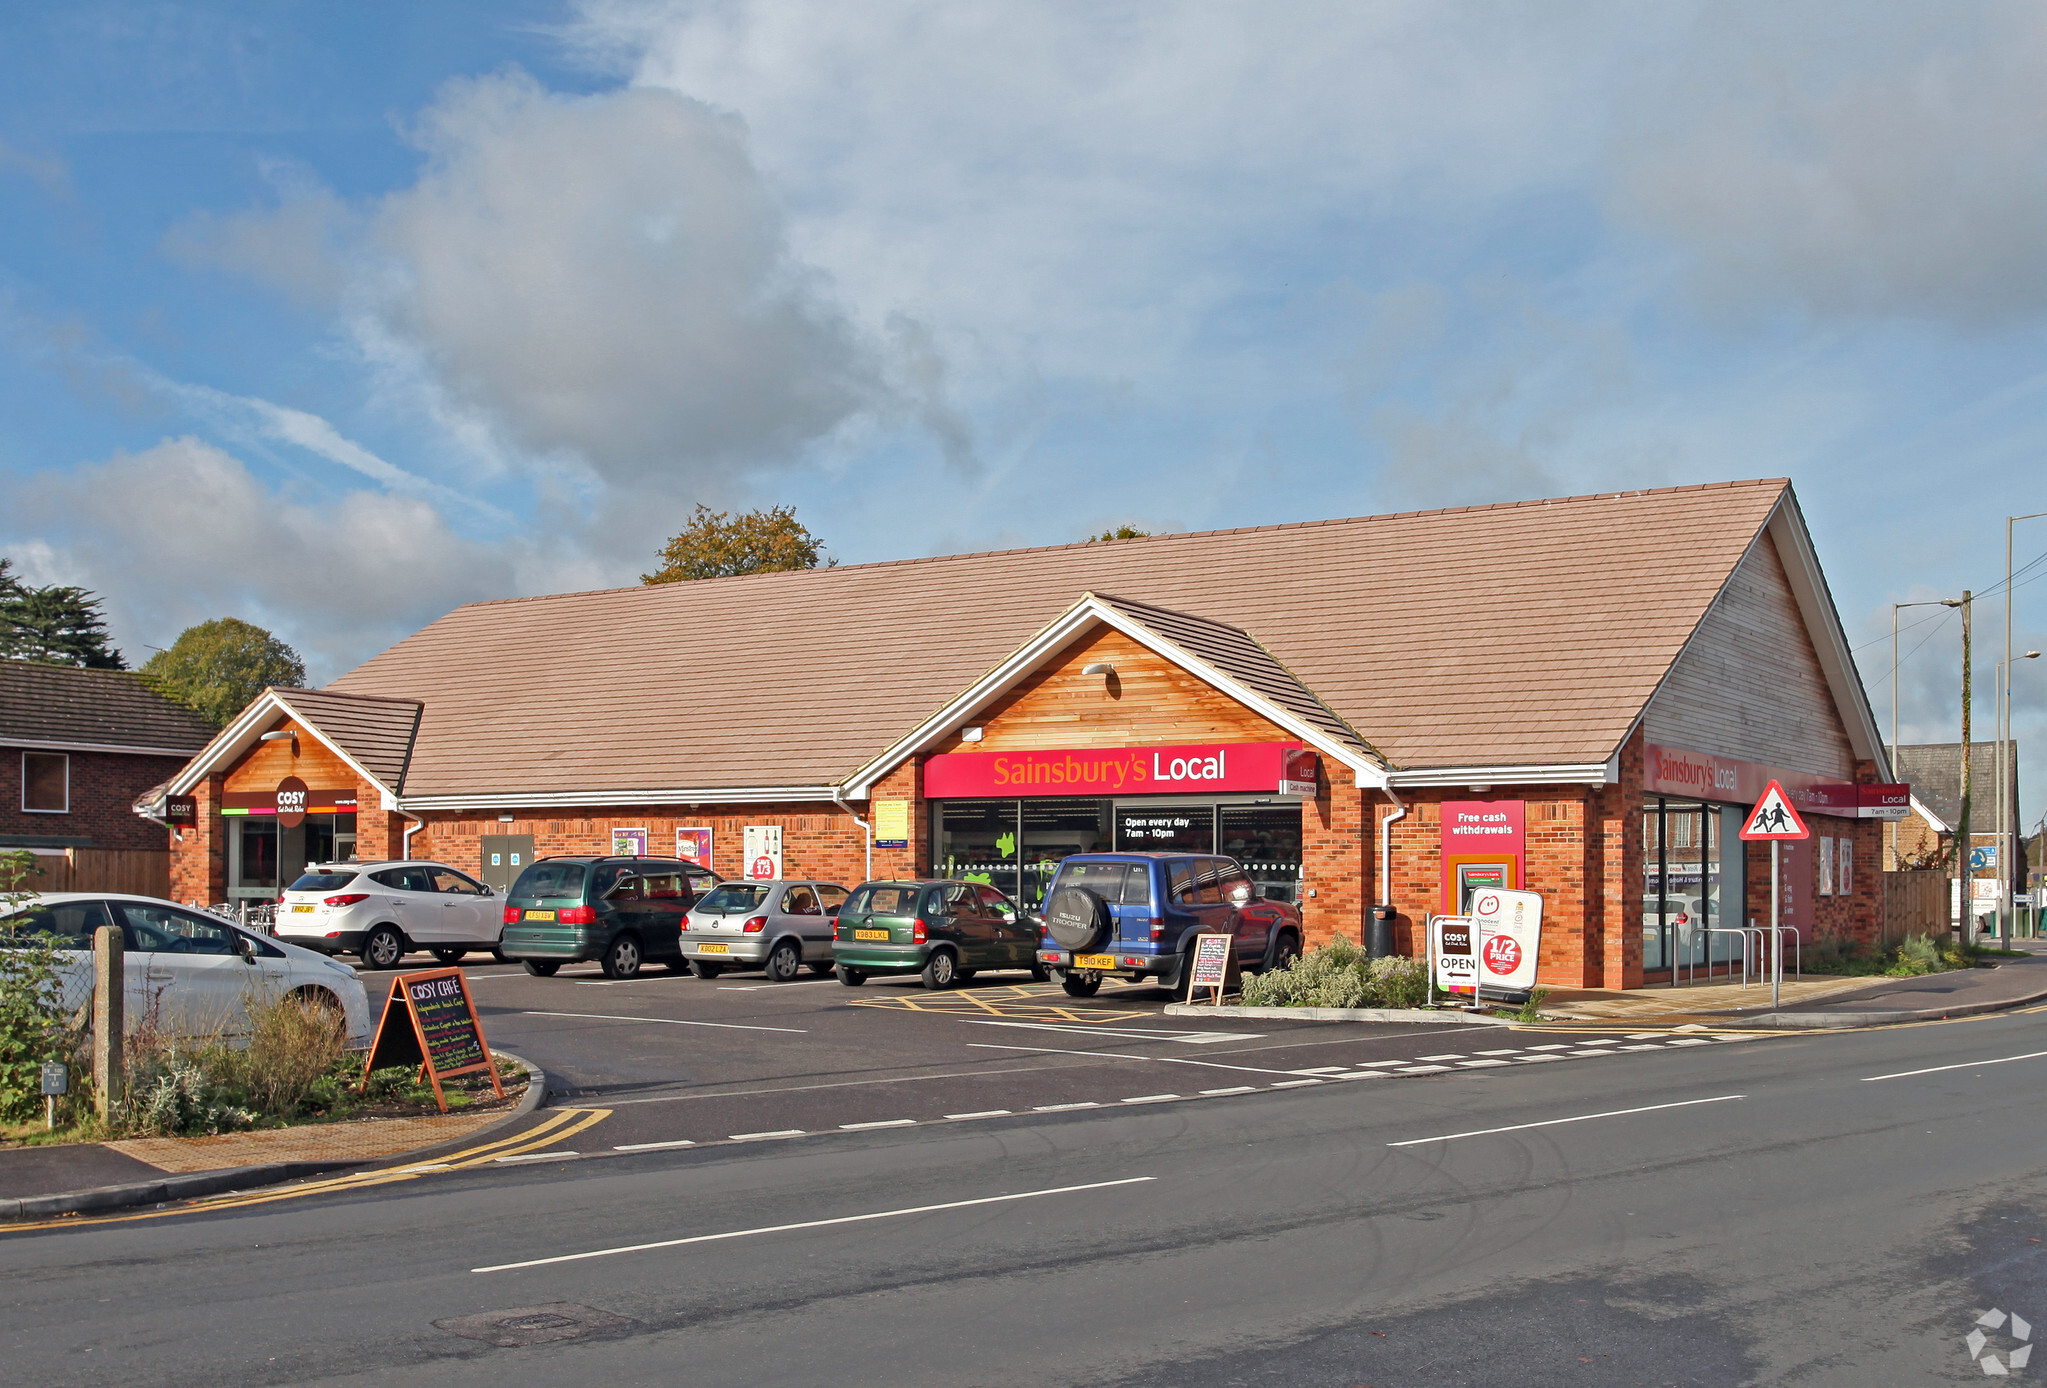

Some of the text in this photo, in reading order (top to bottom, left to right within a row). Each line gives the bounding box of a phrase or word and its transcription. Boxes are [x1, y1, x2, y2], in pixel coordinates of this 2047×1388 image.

[993, 750, 1226, 788] Sainsbury's Local
[1300, 765, 1315, 778] Local
[1655, 751, 1737, 792] Sainsbury's Local
[1290, 783, 1315, 793] Cash machine
[277, 791, 306, 805] COSY
[1882, 795, 1907, 804] Local
[170, 804, 191, 812] COSY
[1457, 812, 1507, 822] Free cash
[1125, 817, 1190, 828] Open every day
[1125, 828, 1144, 838] 7am
[1151, 828, 1175, 839] 10pm
[1452, 824, 1513, 834] withdrawals
[756, 865, 771, 875] 1/3
[1059, 911, 1081, 921] ISUZU
[1052, 916, 1087, 930] TROOPER
[856, 930, 888, 939] X983 LKL
[1444, 933, 1468, 942] COSY
[1490, 938, 1516, 955] 1/2
[1079, 956, 1112, 966] T910 KEF
[1490, 952, 1515, 962] PRICE
[1441, 957, 1476, 970] OPEN
[410, 976, 461, 1000] COSY CAFÉ
